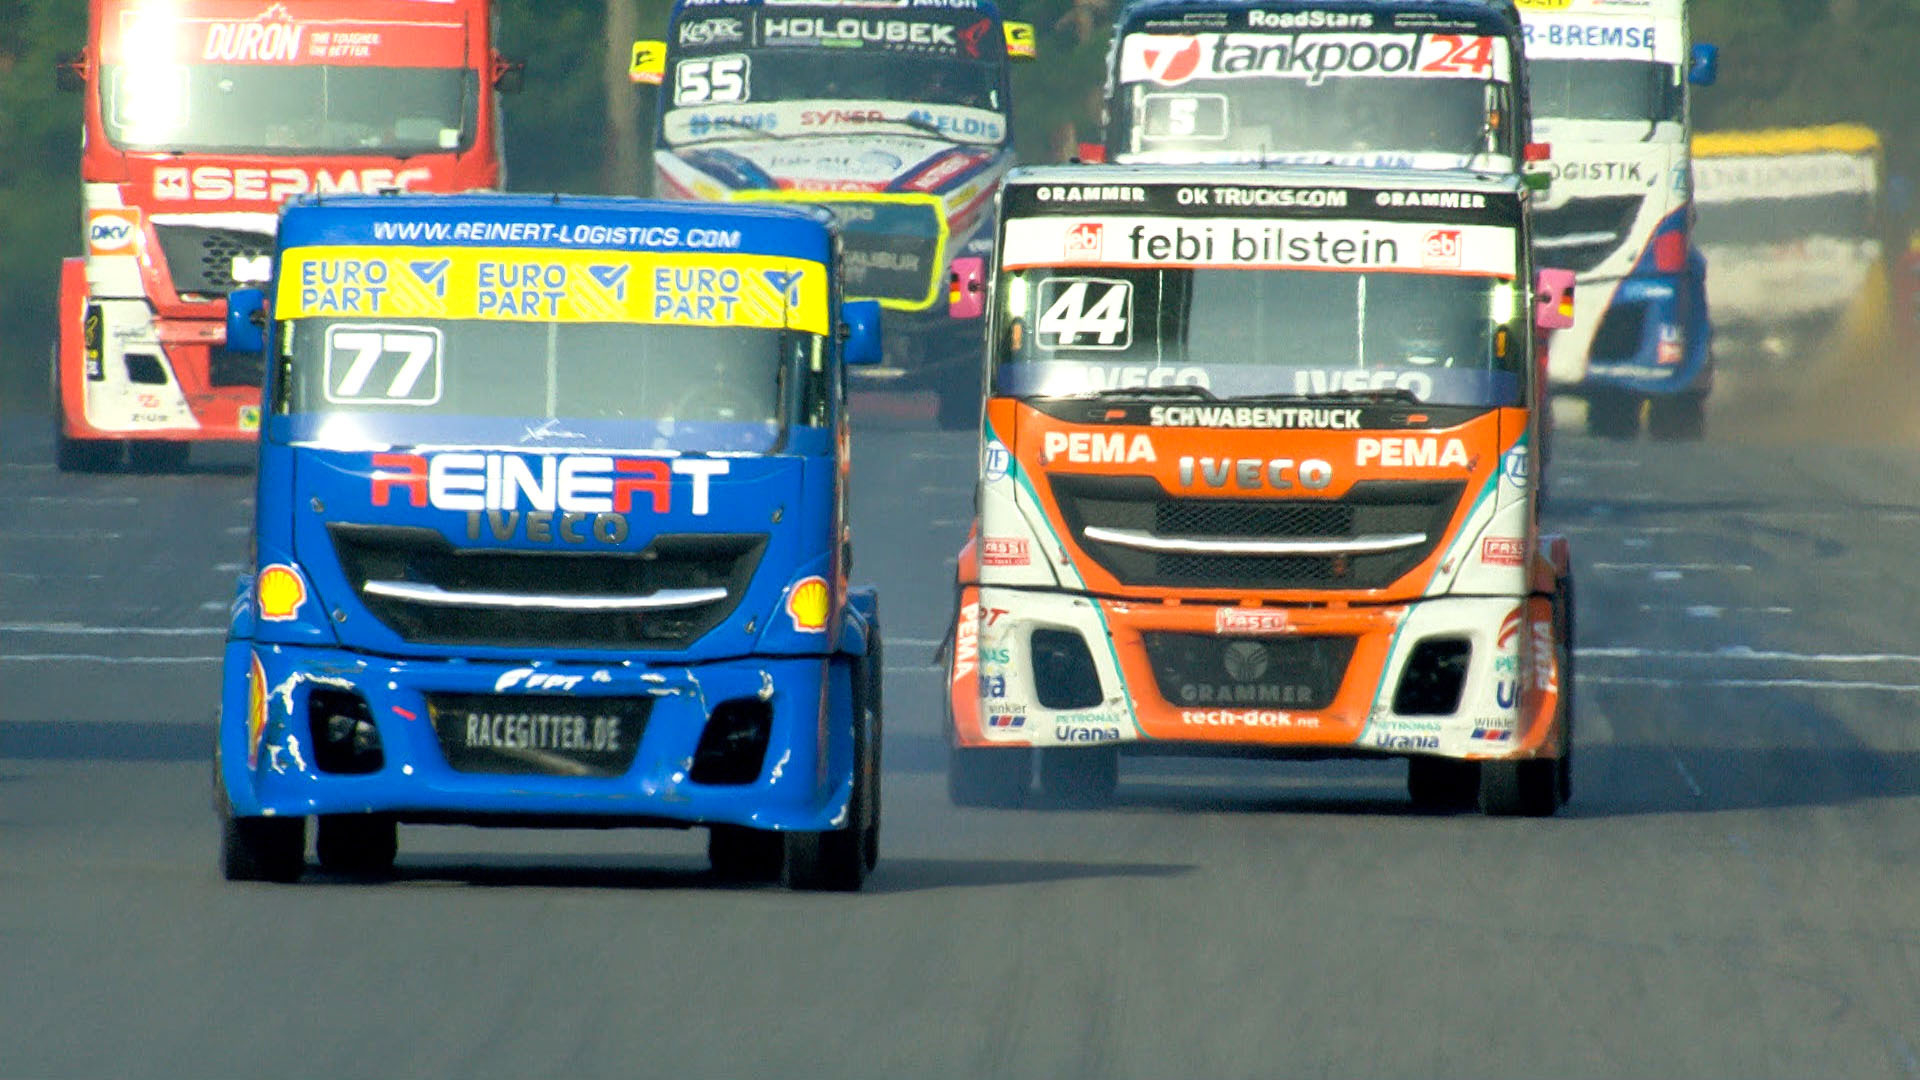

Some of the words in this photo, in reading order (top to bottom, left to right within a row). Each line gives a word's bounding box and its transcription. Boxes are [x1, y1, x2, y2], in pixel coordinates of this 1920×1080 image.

[764, 18, 956, 44] HOLOUBEK
[1249, 10, 1373, 28] RoadStars
[203, 23, 301, 60] DURON
[1210, 33, 1493, 85] tankpool24
[680, 61, 745, 102] 55
[937, 117, 1001, 138] ELDIS
[1168, 99, 1199, 135] 5
[192, 166, 432, 201] SERMEC
[1036, 187, 1145, 202] GRAMMER
[1177, 188, 1209, 205] OK
[1375, 191, 1486, 208] GRAMMER
[373, 222, 742, 248] WWW.REINERT-LOGISTICS.COM
[1128, 225, 1213, 260] febi
[1232, 226, 1398, 264] bilstein
[303, 261, 387, 286] EURO
[478, 262, 566, 288] EURO
[655, 268, 740, 293] EURO
[302, 287, 387, 312] PART
[478, 291, 566, 316] PART
[654, 295, 740, 319] PART
[1040, 282, 1128, 345] 44
[333, 332, 434, 397] 77
[1075, 366, 1210, 391] VECO
[1295, 370, 1432, 401] IVECO
[1150, 406, 1361, 429] SCHWABENTRUCK
[1044, 431, 1157, 463] PEMA
[1355, 437, 1468, 467] PEMA
[371, 453, 730, 516] REINERT
[1178, 456, 1333, 490] IVECO
[465, 510, 629, 544] IVECO
[524, 673, 584, 690] FPT
[1180, 684, 1313, 704] GRAMMER
[466, 713, 622, 750] RACEGITTER.DE
[1055, 725, 1120, 742] Urania
[1376, 731, 1440, 749] Urania
